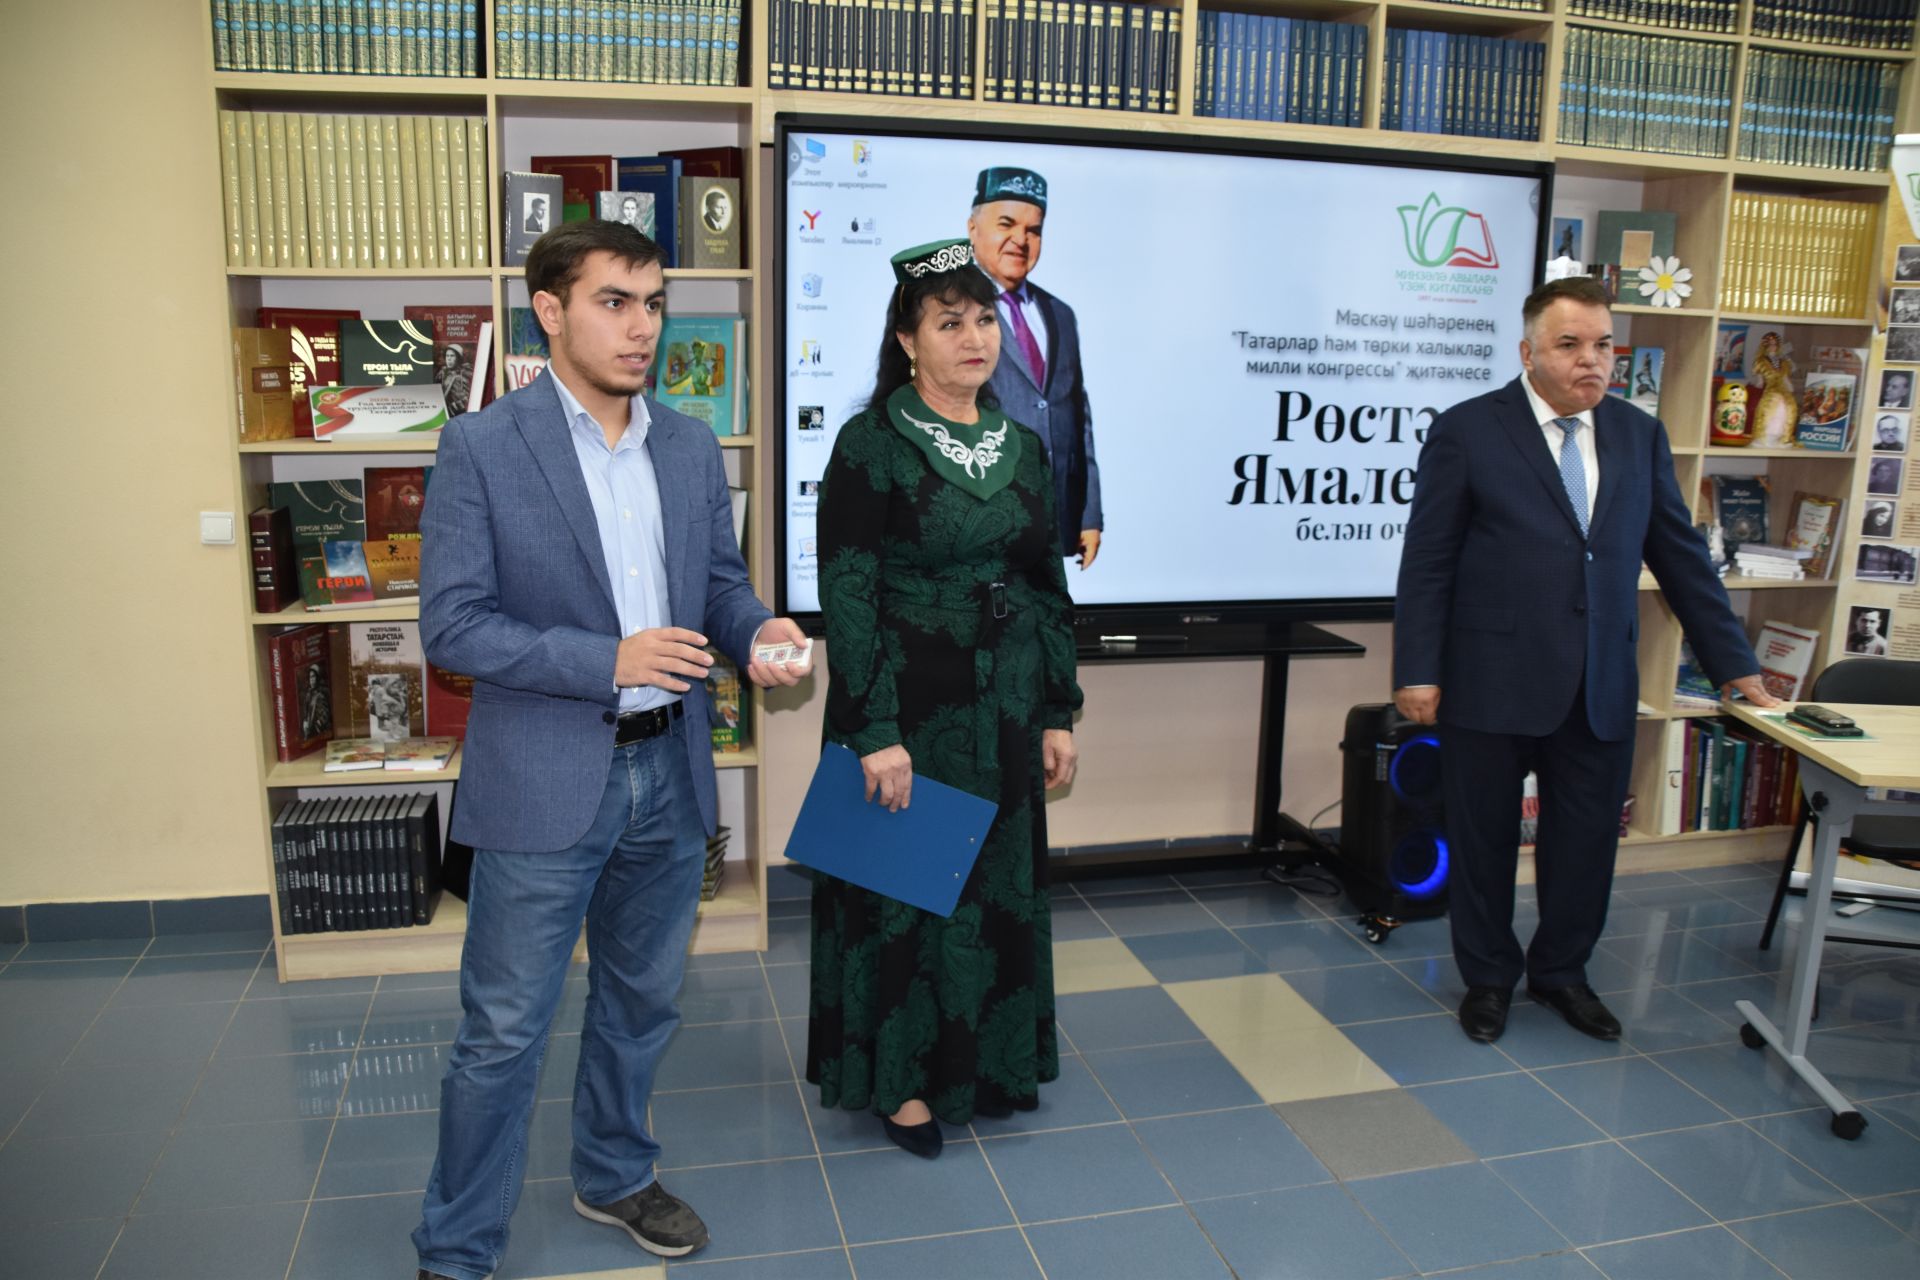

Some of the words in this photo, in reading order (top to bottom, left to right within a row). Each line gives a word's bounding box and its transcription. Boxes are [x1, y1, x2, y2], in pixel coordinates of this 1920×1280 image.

[1336, 309, 1397, 331] Мәскәү
[1403, 312, 1495, 333] шәһәренең
[1231, 331, 1318, 351] "Татарлар
[1324, 334, 1357, 352] һәм
[1363, 339, 1410, 357] төрки
[1416, 342, 1493, 359] халыклар
[363, 363, 389, 371] ГЕРОИ
[390, 363, 414, 371] ТЫЛА
[1247, 360, 1301, 375] милли
[1307, 361, 1402, 380] конгрессы"
[1406, 363, 1491, 381] җитәкчесе
[1799, 431, 1841, 443] РОССИИ
[1296, 517, 1372, 541] белән
[317, 575, 365, 589] ГЕРОИ
